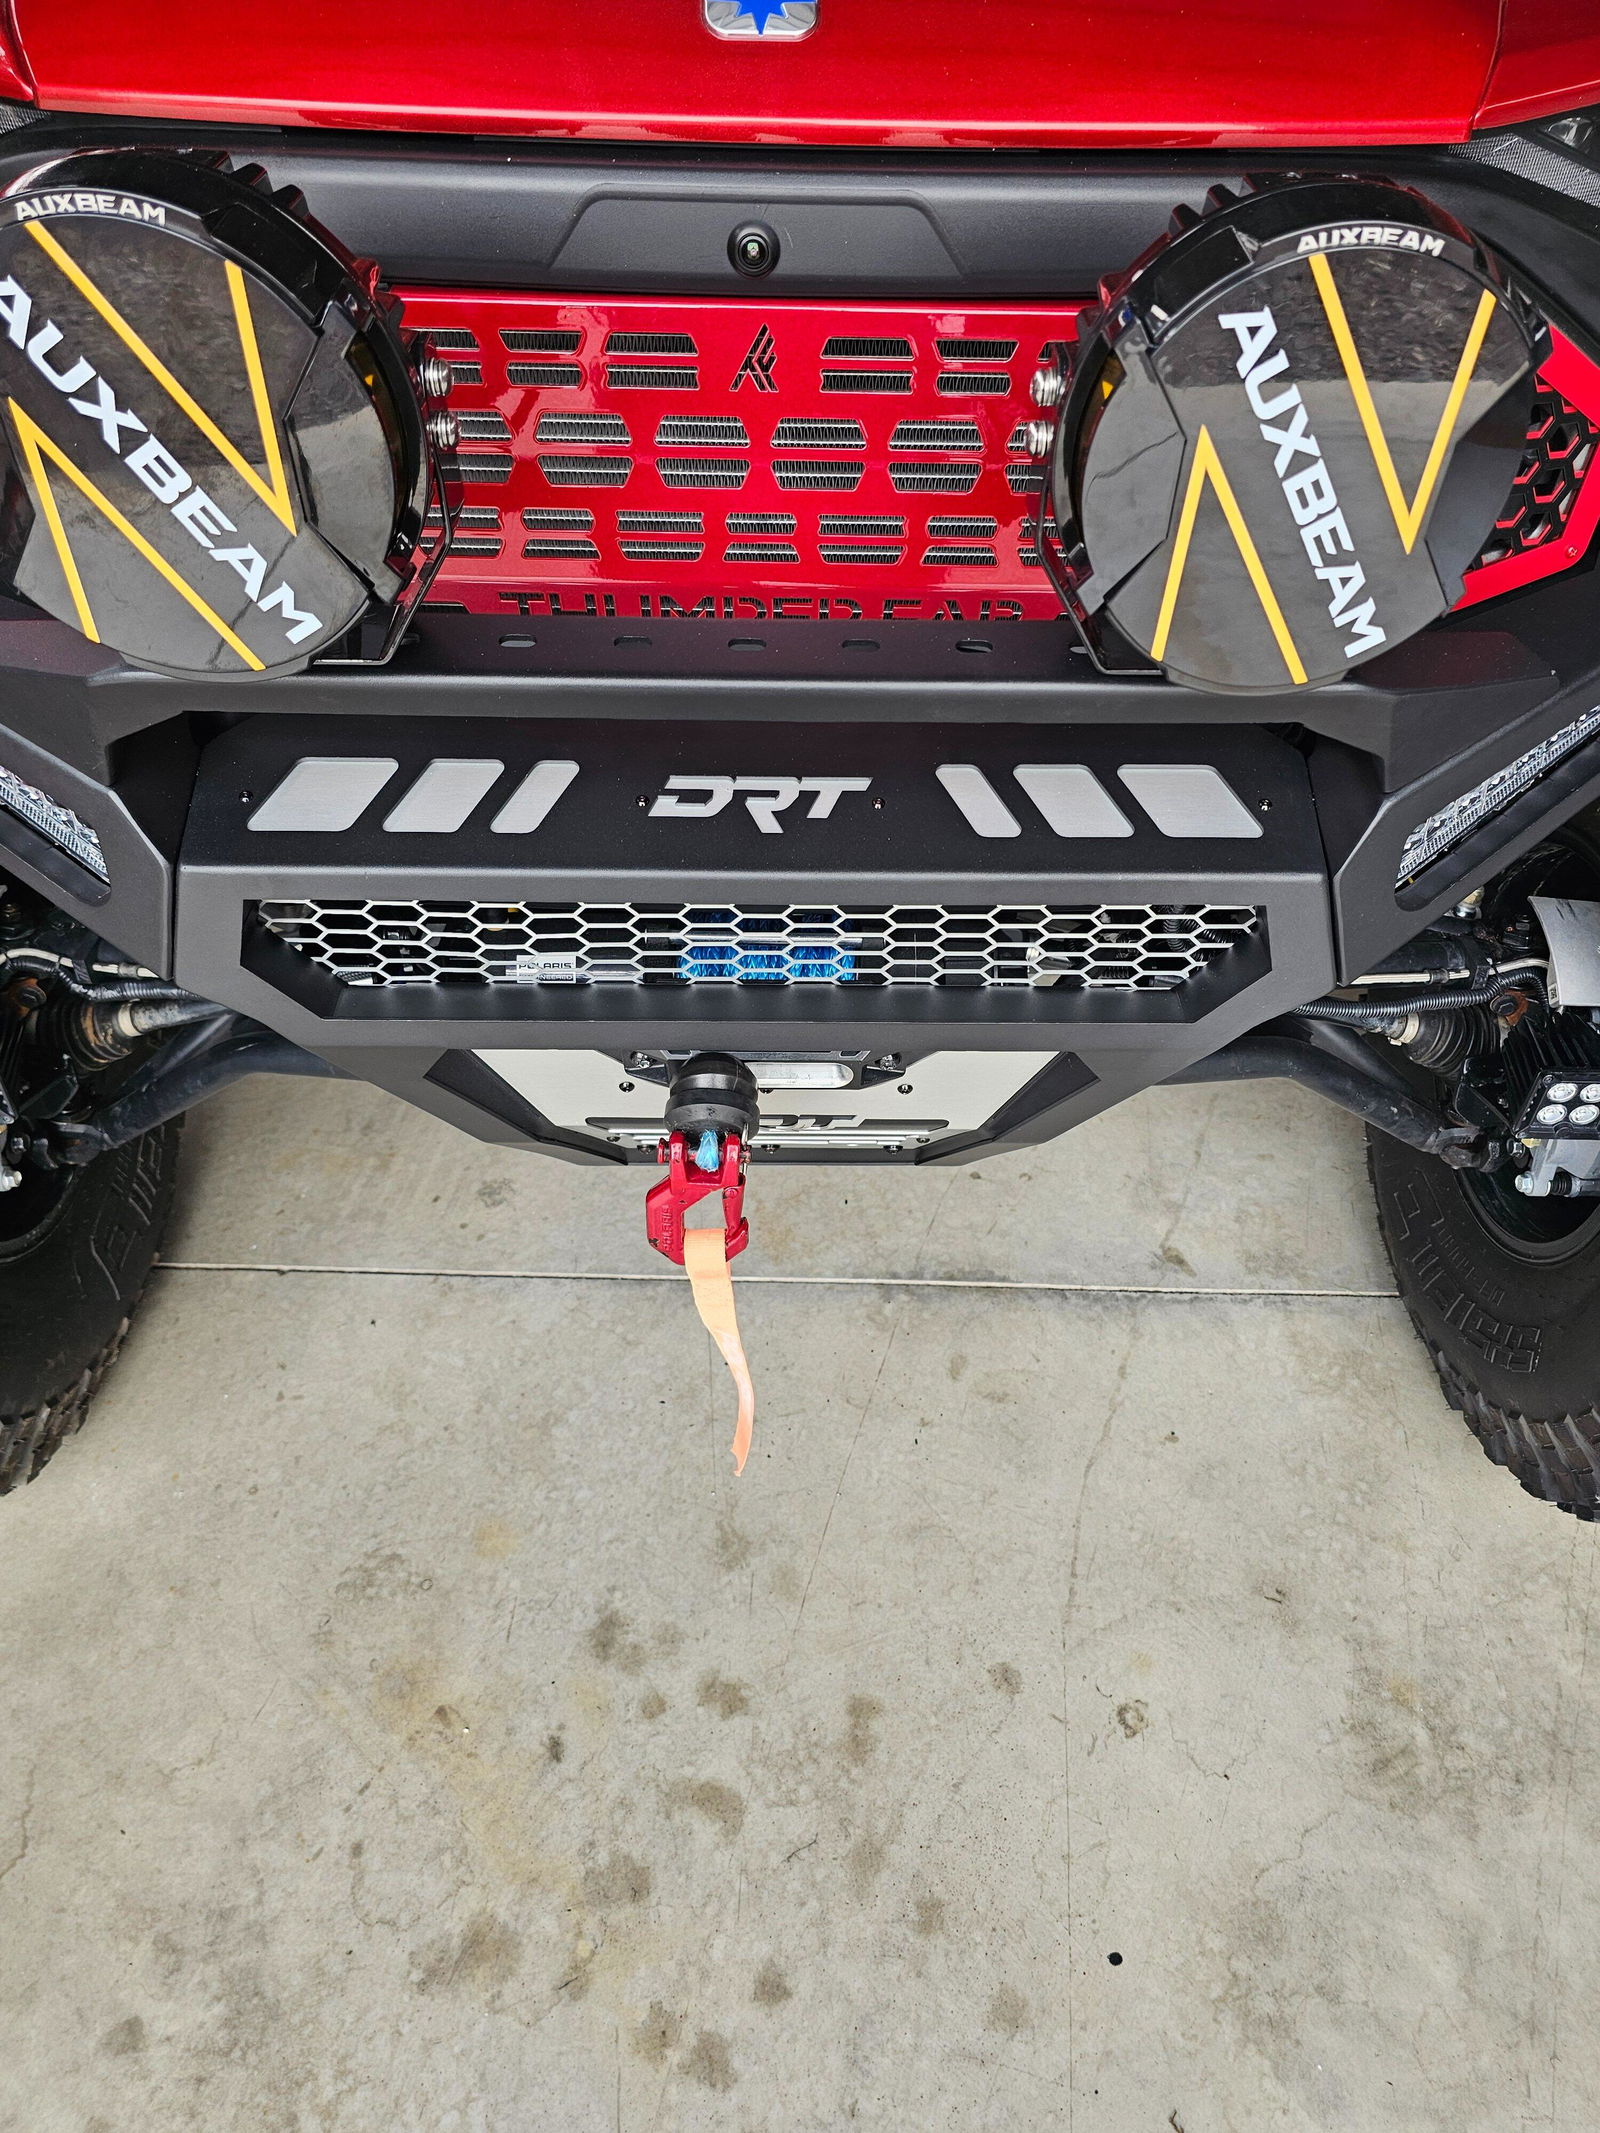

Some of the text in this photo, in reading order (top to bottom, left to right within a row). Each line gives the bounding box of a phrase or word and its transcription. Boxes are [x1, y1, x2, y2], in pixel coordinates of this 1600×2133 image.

[15, 192, 167, 227] AUXBEAM
[1296, 226, 1446, 257] AUXBEAM
[0, 274, 323, 645] AUXBEAM
[1217, 306, 1387, 659] AUXBEAM
[647, 775, 874, 834] DRT
[518, 962, 573, 970] POARIS
